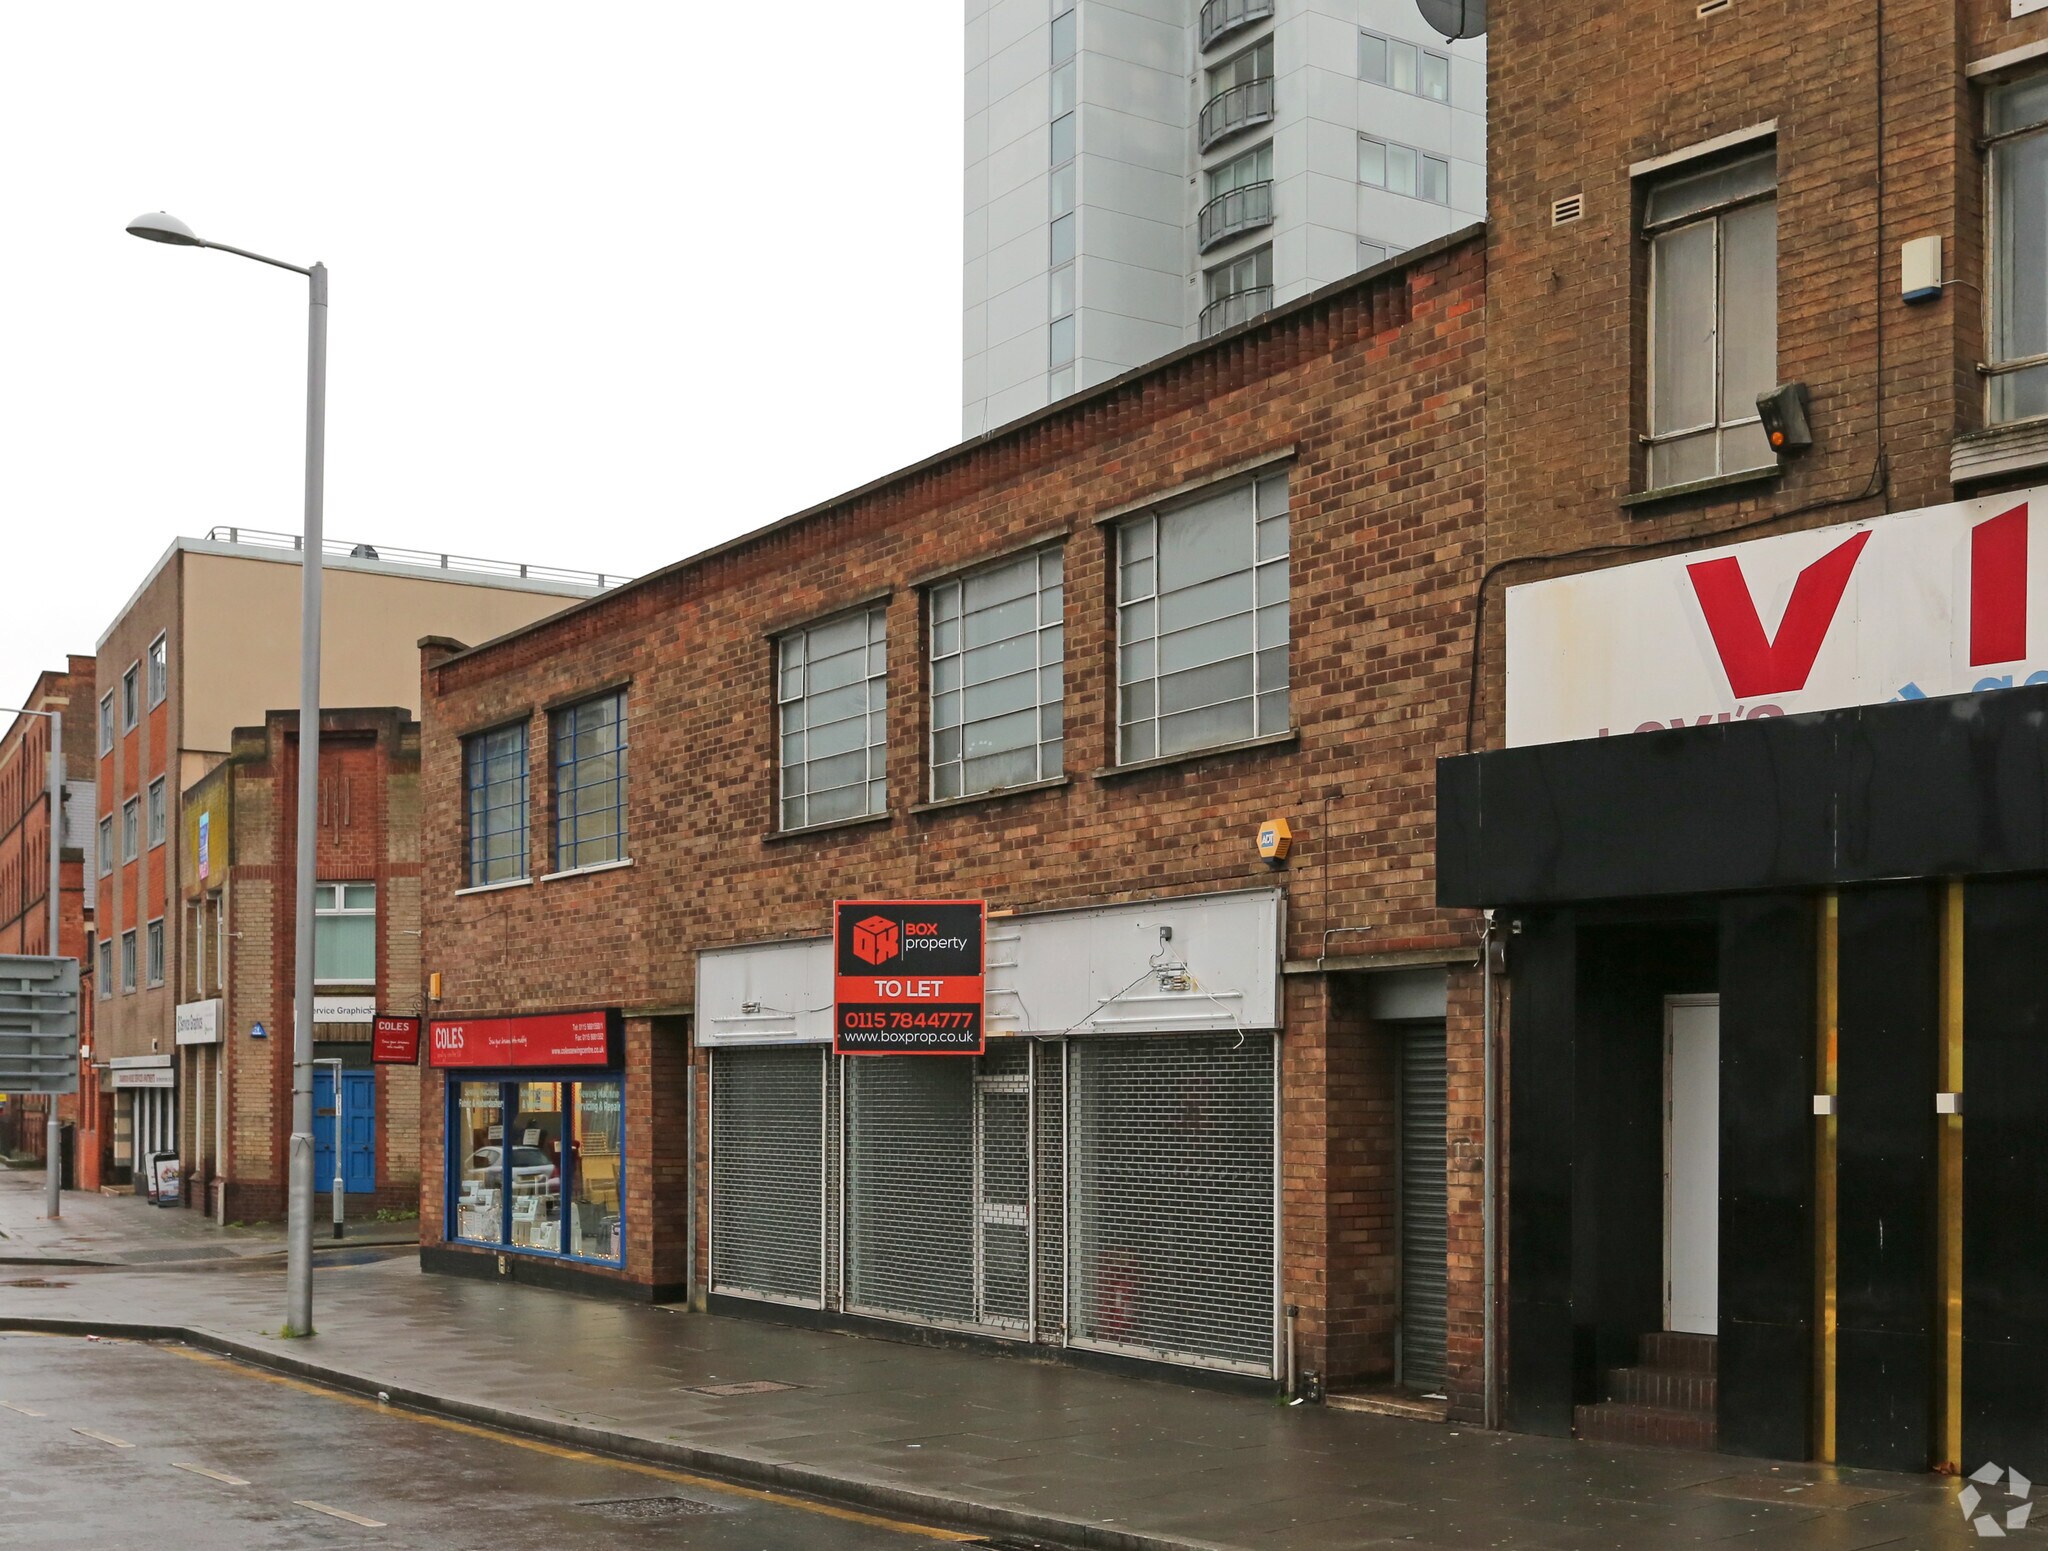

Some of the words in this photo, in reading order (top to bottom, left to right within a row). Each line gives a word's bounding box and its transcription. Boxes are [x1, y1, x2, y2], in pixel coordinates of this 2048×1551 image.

[1262, 833, 1274, 844] ADT
[905, 923, 938, 936] BOX
[905, 937, 968, 951] property
[874, 980, 902, 997] TO
[906, 980, 944, 997] LET
[337, 1006, 372, 1016] Graphics
[379, 1021, 410, 1032] COLES
[845, 1012, 887, 1029] 0115
[890, 1012, 974, 1029] 7844777
[435, 1026, 464, 1049] COLES
[844, 1031, 974, 1045] www.boxprop.co.uk
